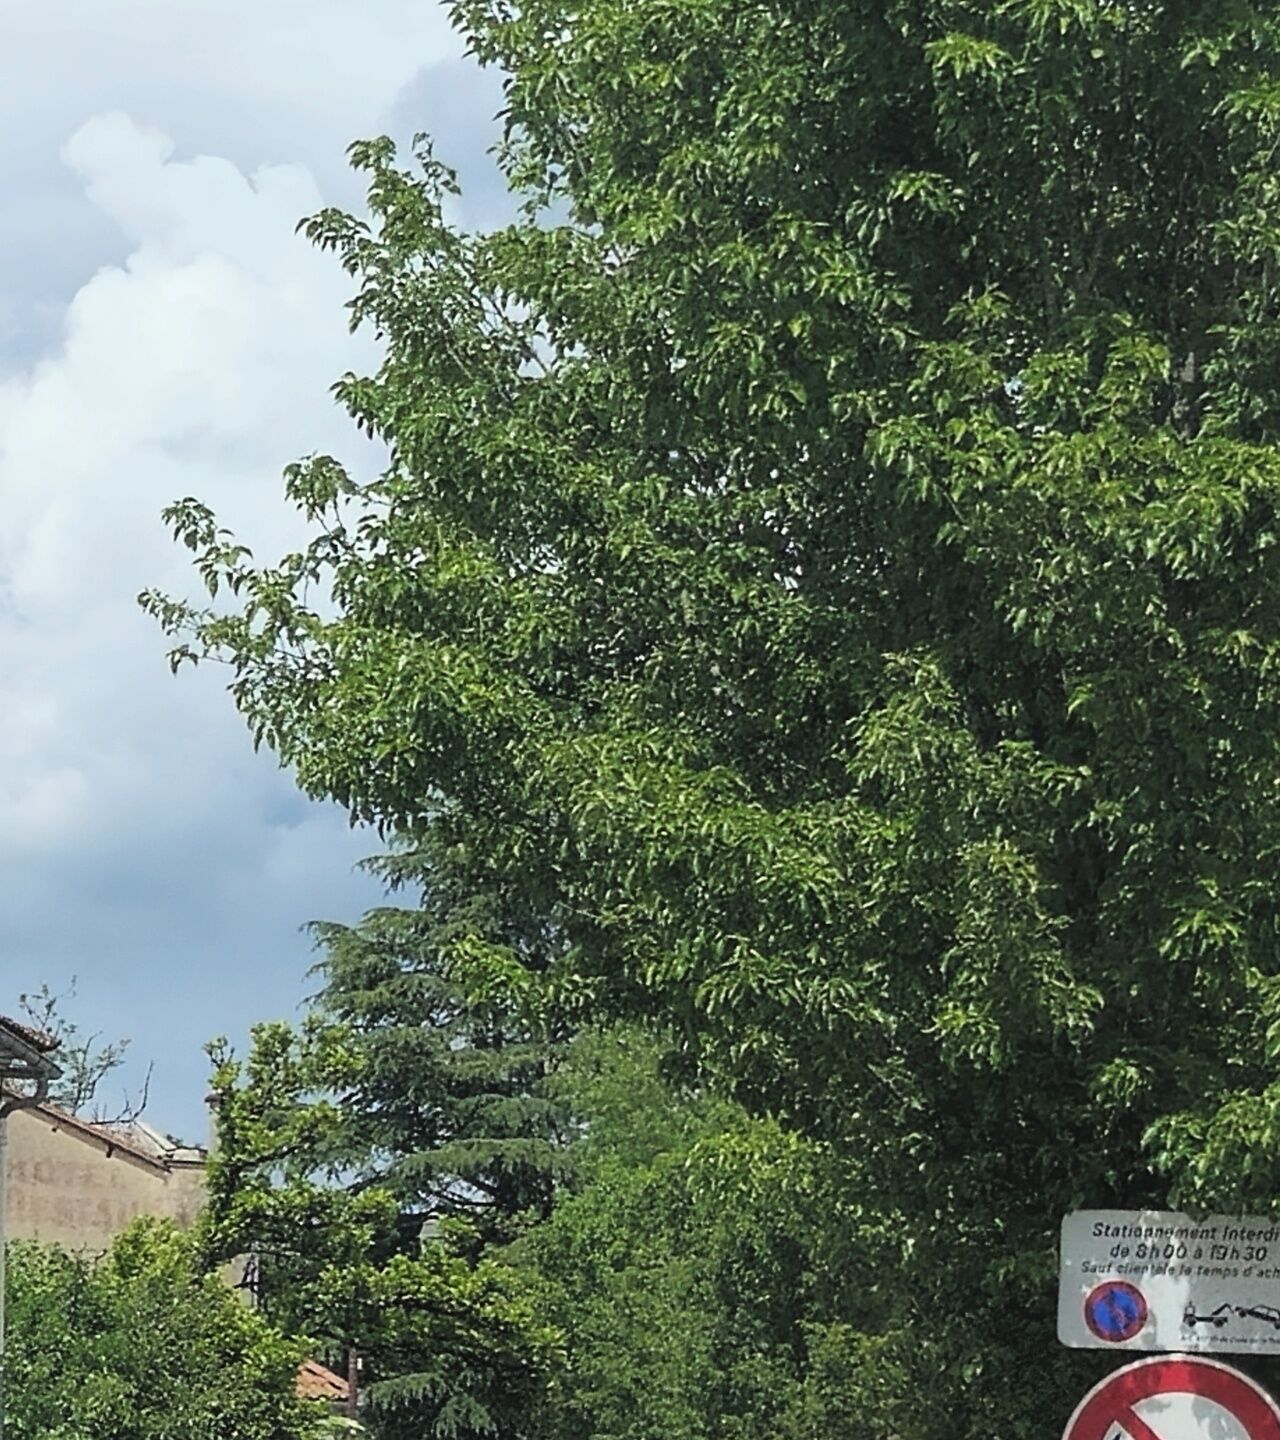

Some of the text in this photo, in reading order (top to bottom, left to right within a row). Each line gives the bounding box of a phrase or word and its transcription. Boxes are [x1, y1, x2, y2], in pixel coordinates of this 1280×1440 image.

[1092, 1222, 1280, 1242] Stationnement Interdi
[1109, 1243, 1130, 1258] de
[1081, 1260, 1113, 1274] Sauf
[1196, 1265, 1239, 1279] temps
[1242, 1265, 1280, 1279] d'ach
